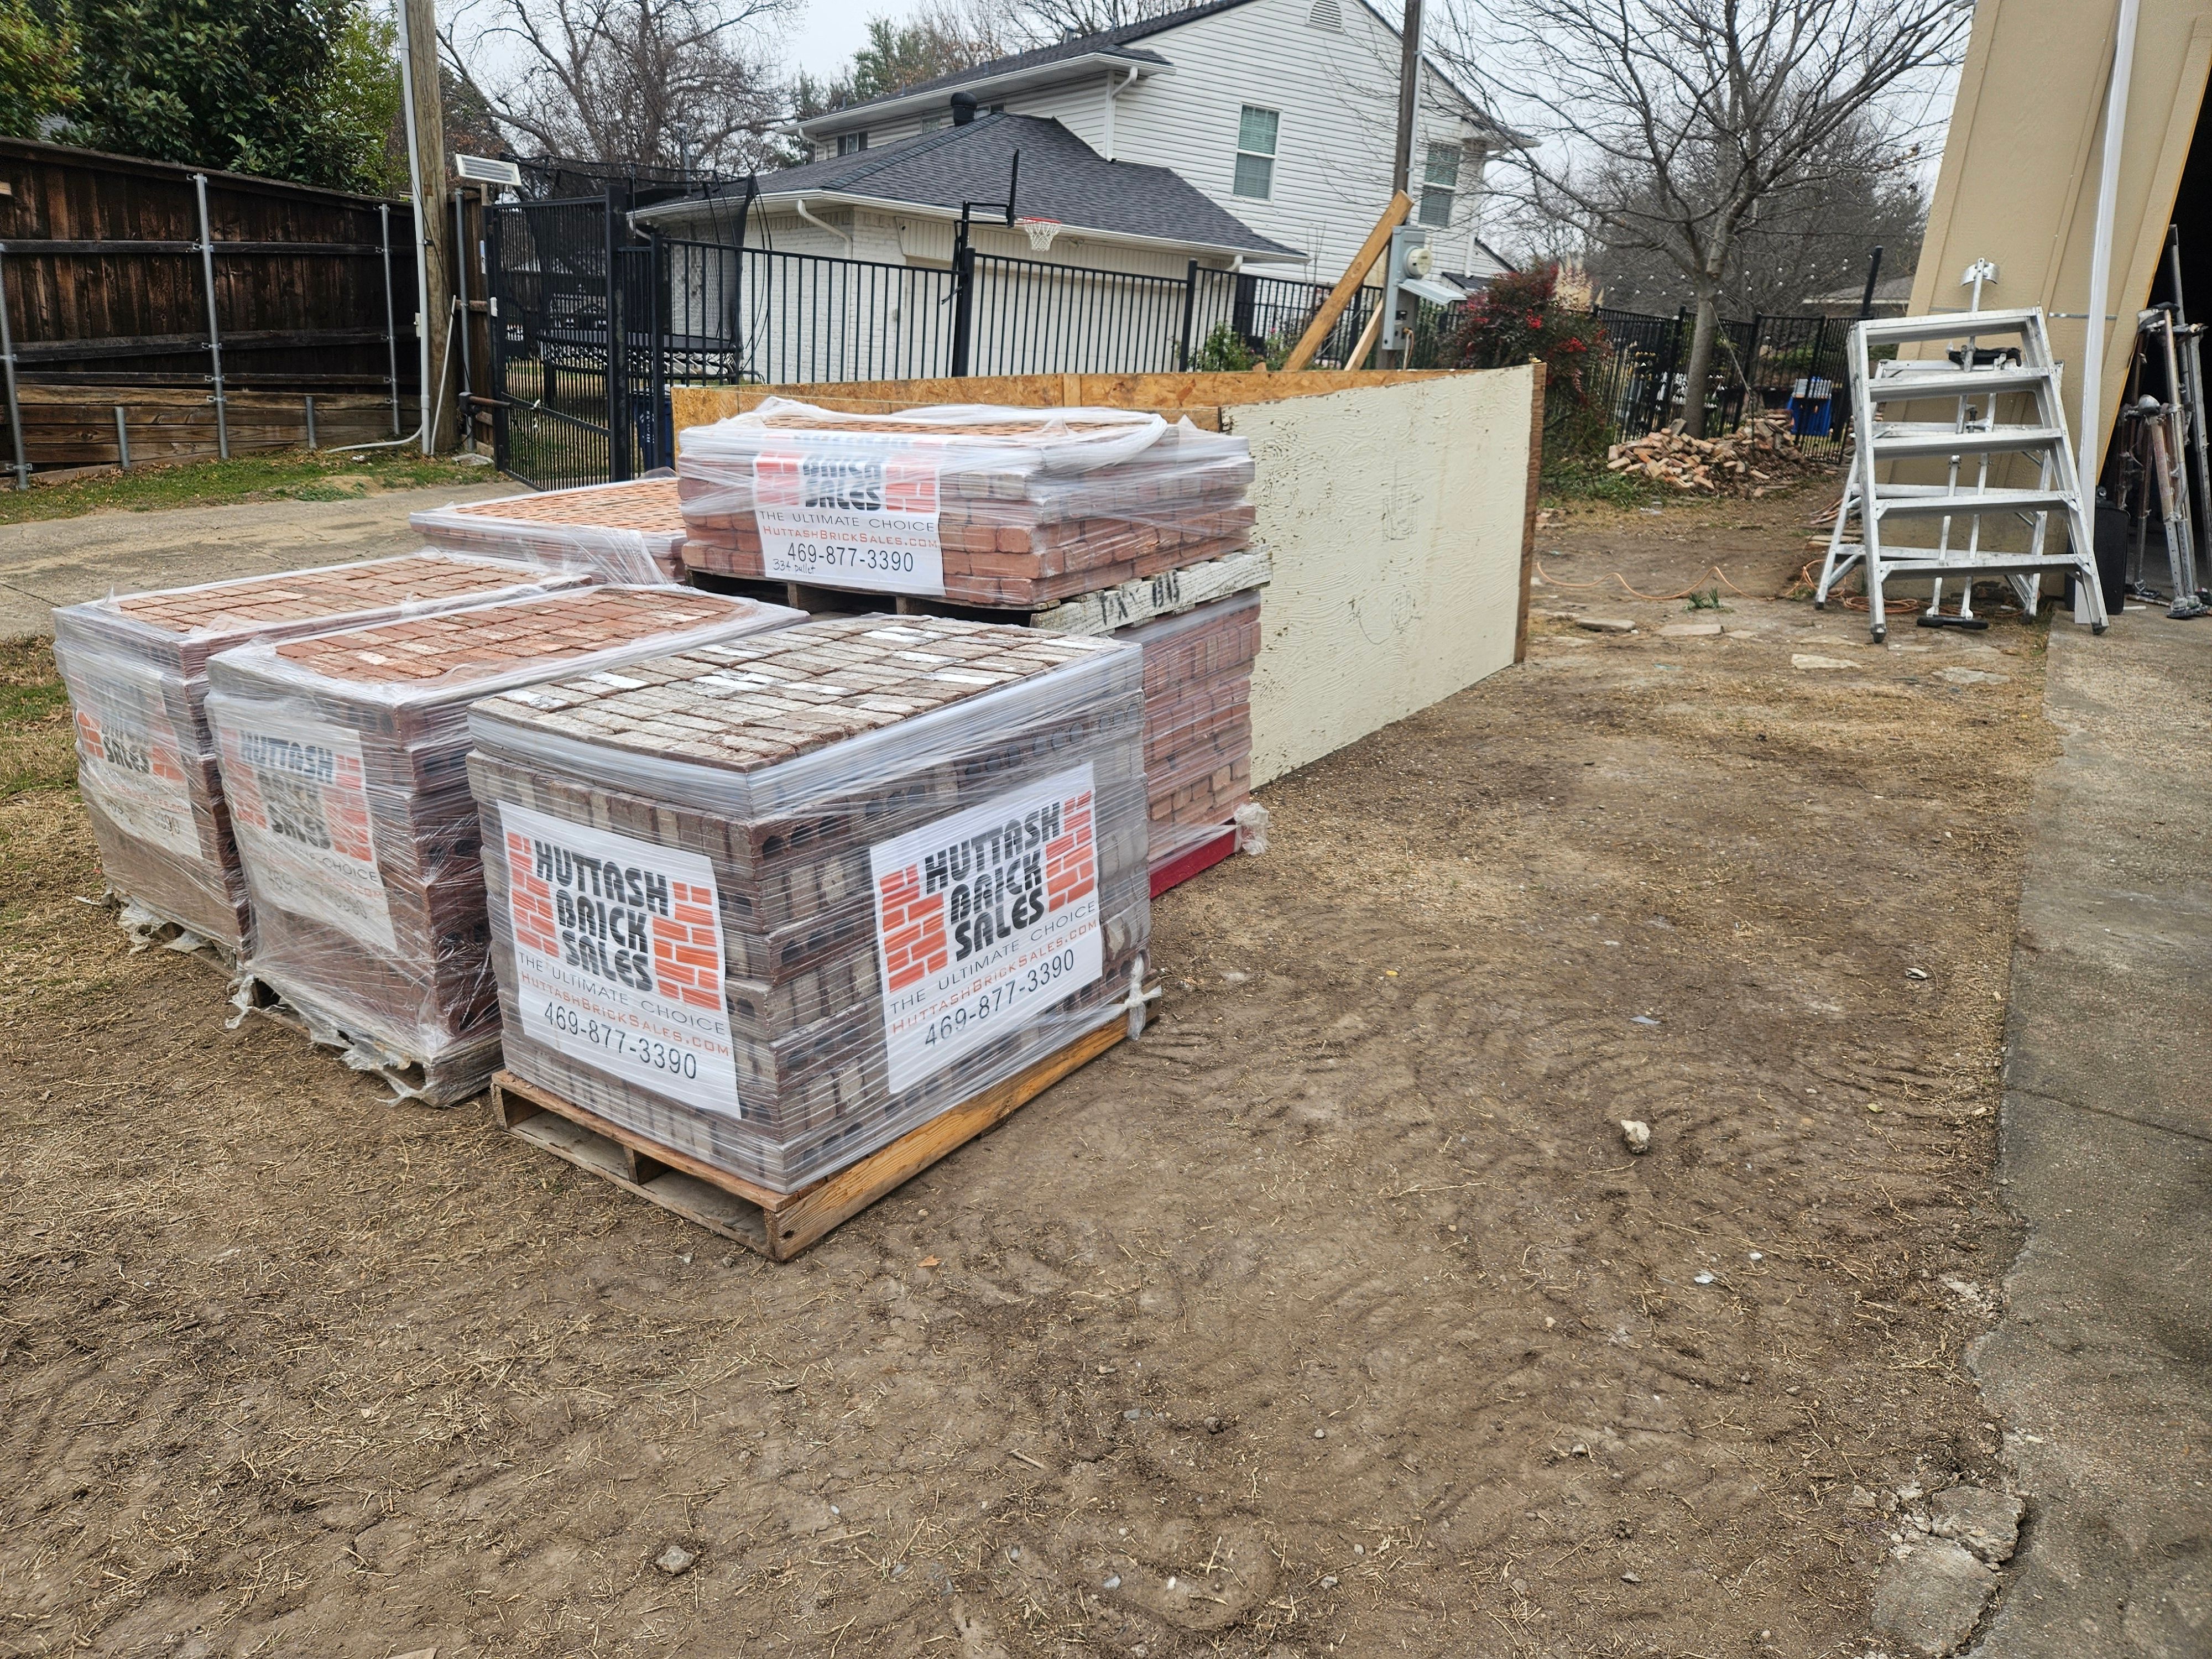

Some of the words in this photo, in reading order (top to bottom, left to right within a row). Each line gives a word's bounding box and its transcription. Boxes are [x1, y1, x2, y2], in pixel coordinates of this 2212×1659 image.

[759, 510, 785, 521] THE
[792, 513, 860, 527] ULTIMATE
[869, 518, 935, 533] CHOICE
[805, 479, 882, 511] SALES
[787, 542, 914, 572] 469-877-3390
[322, 857, 378, 882] CHOICE
[534, 839, 670, 917] HUTTASH
[924, 801, 1061, 894] HUTTASH
[555, 889, 649, 954] BRICK
[950, 848, 1043, 925] BRICK
[561, 930, 654, 992] SALES
[890, 989, 925, 1014] THE
[938, 939, 1020, 991] ULTIMATE
[1031, 901, 1095, 941] CHOICE
[955, 888, 1045, 962] SALES
[518, 951, 544, 973] THE
[552, 968, 629, 1006] ULTIMATE
[640, 999, 726, 1036] CHOICE
[925, 949, 1074, 1047] 469-877-3390
[544, 1001, 697, 1080] 469-877-3390
